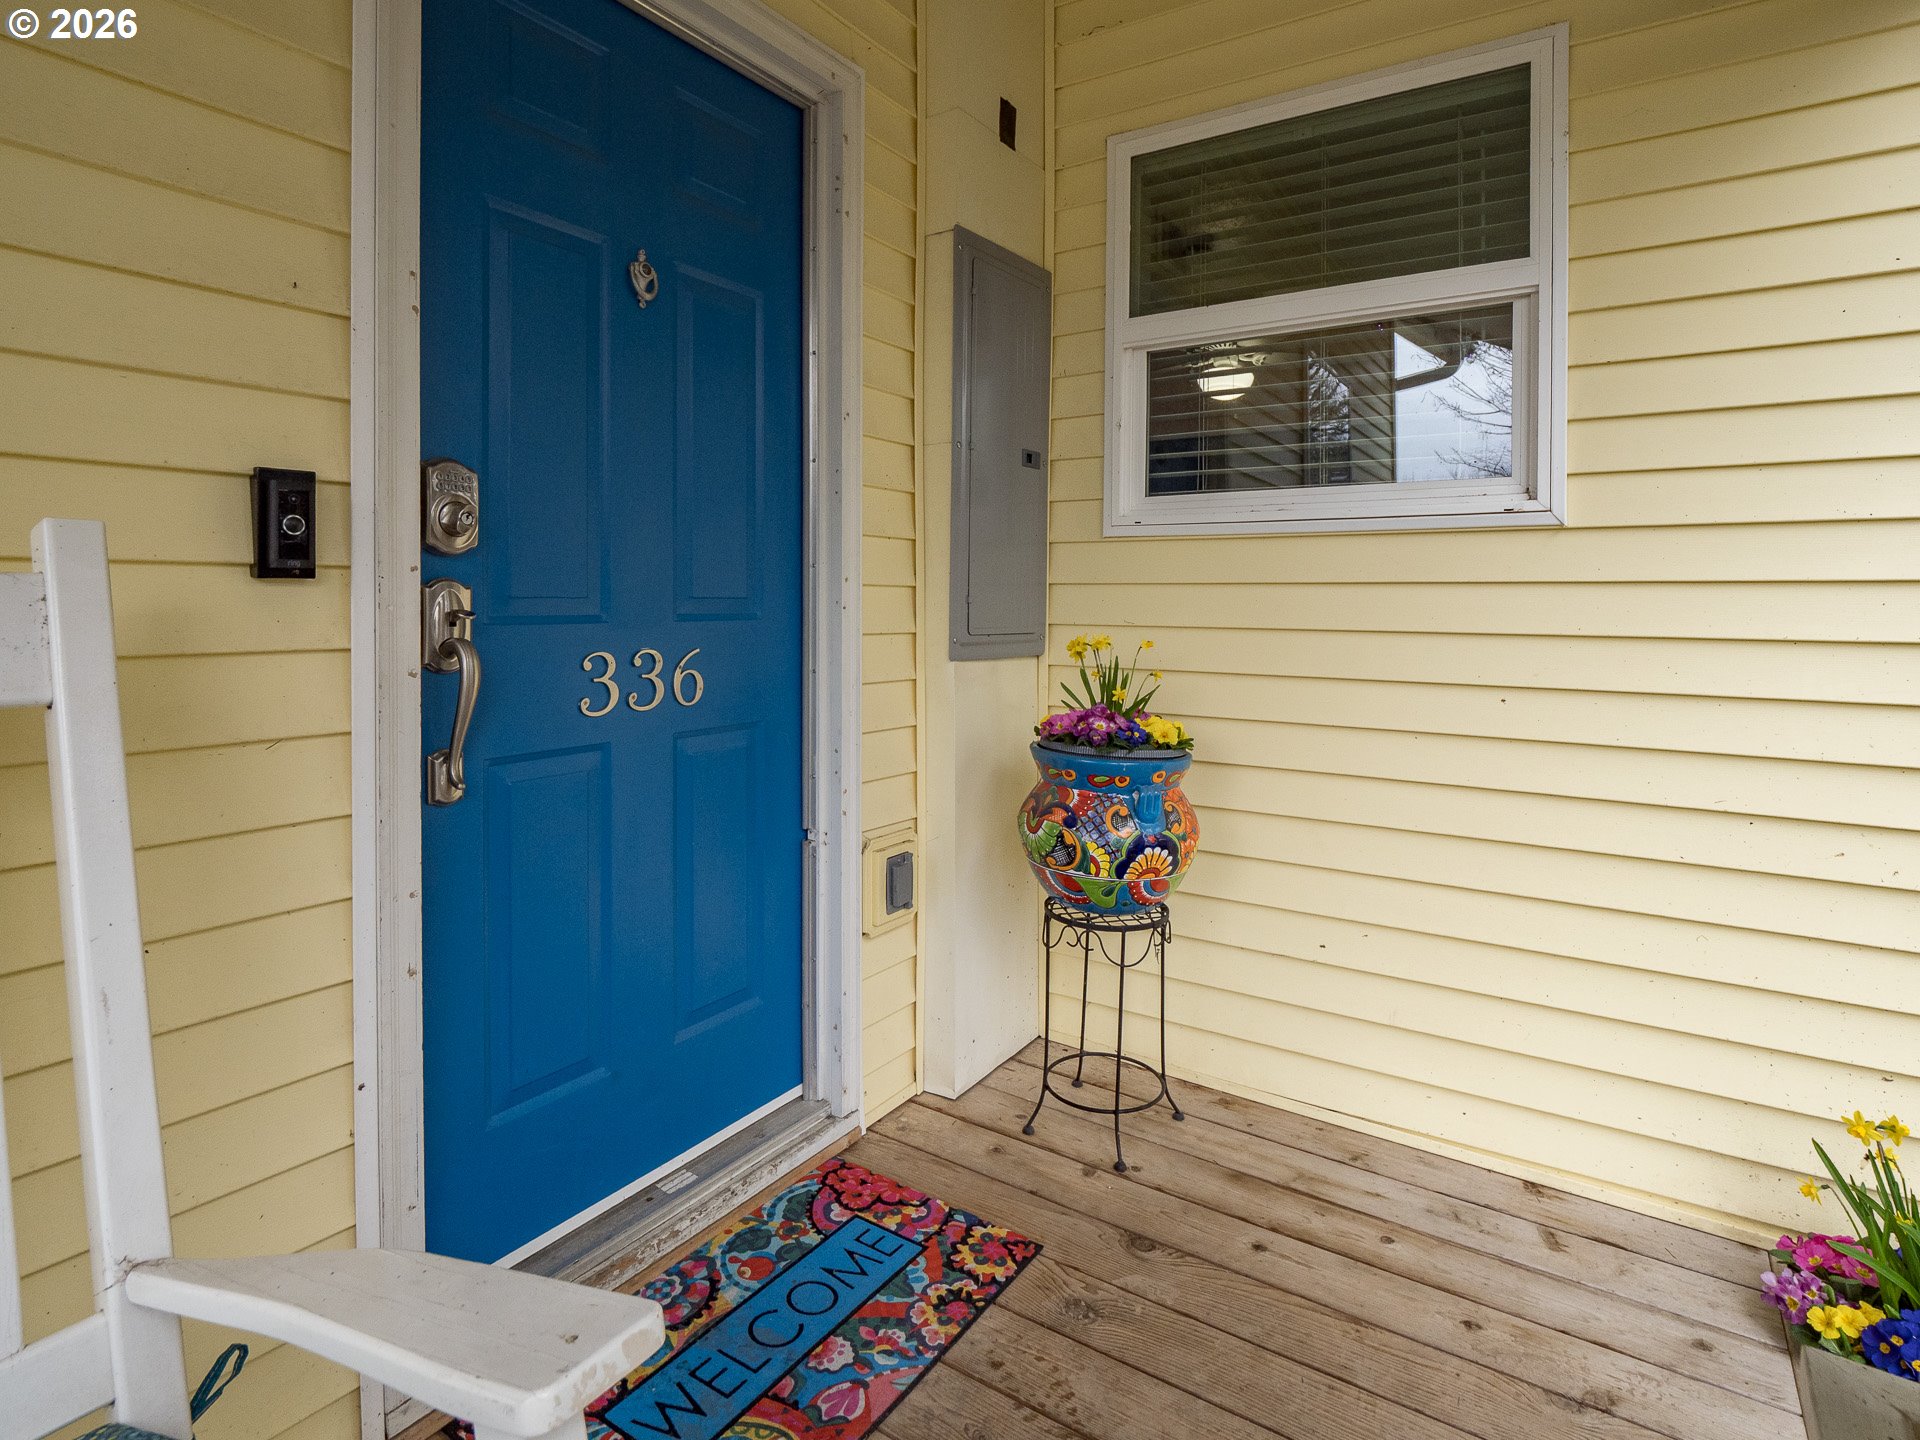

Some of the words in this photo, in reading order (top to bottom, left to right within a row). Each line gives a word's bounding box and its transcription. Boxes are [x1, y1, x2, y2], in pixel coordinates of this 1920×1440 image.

[287, 559, 301, 568] ring
[580, 648, 704, 717] 336
[630, 1227, 905, 1440] WELCOME
